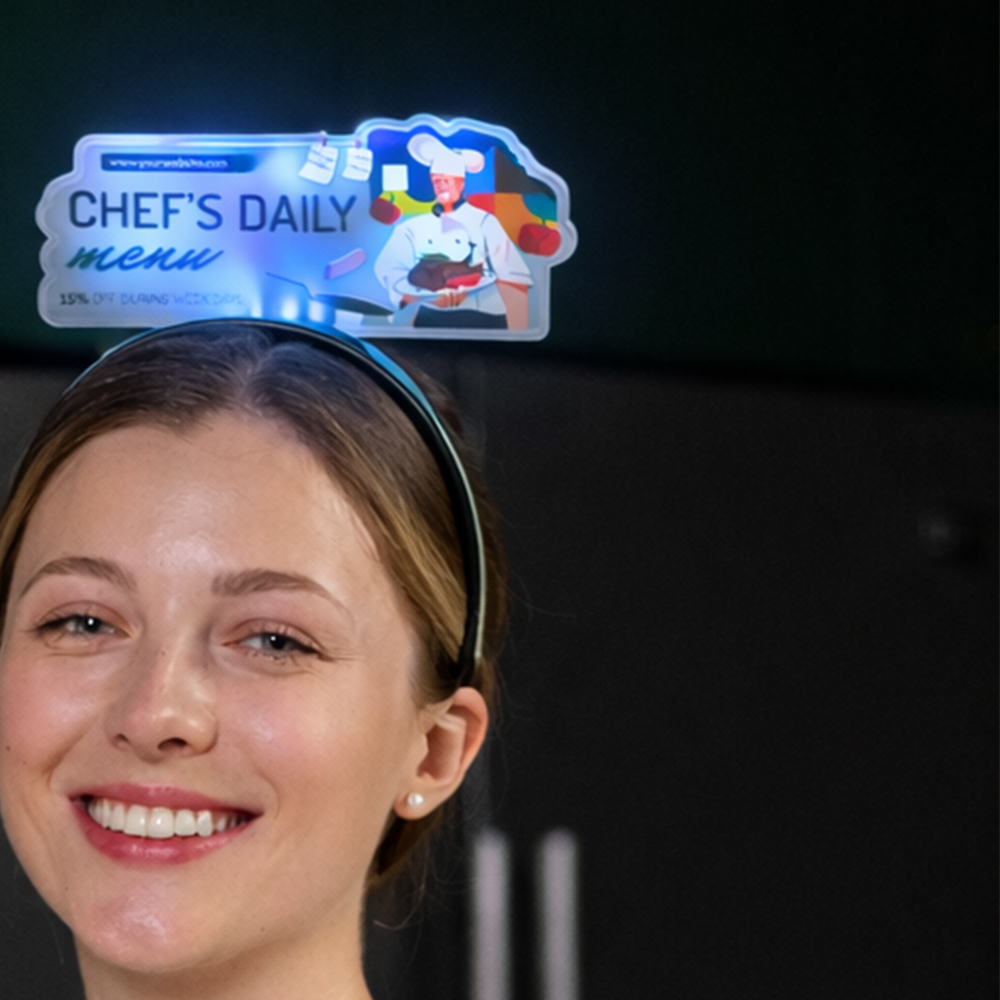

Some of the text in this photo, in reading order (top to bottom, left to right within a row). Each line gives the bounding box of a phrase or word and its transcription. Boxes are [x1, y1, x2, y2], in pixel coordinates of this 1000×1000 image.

[68, 190, 357, 233] CHEF'S DAILY
[66, 246, 224, 271] menu
[60, 292, 90, 306] 15%
